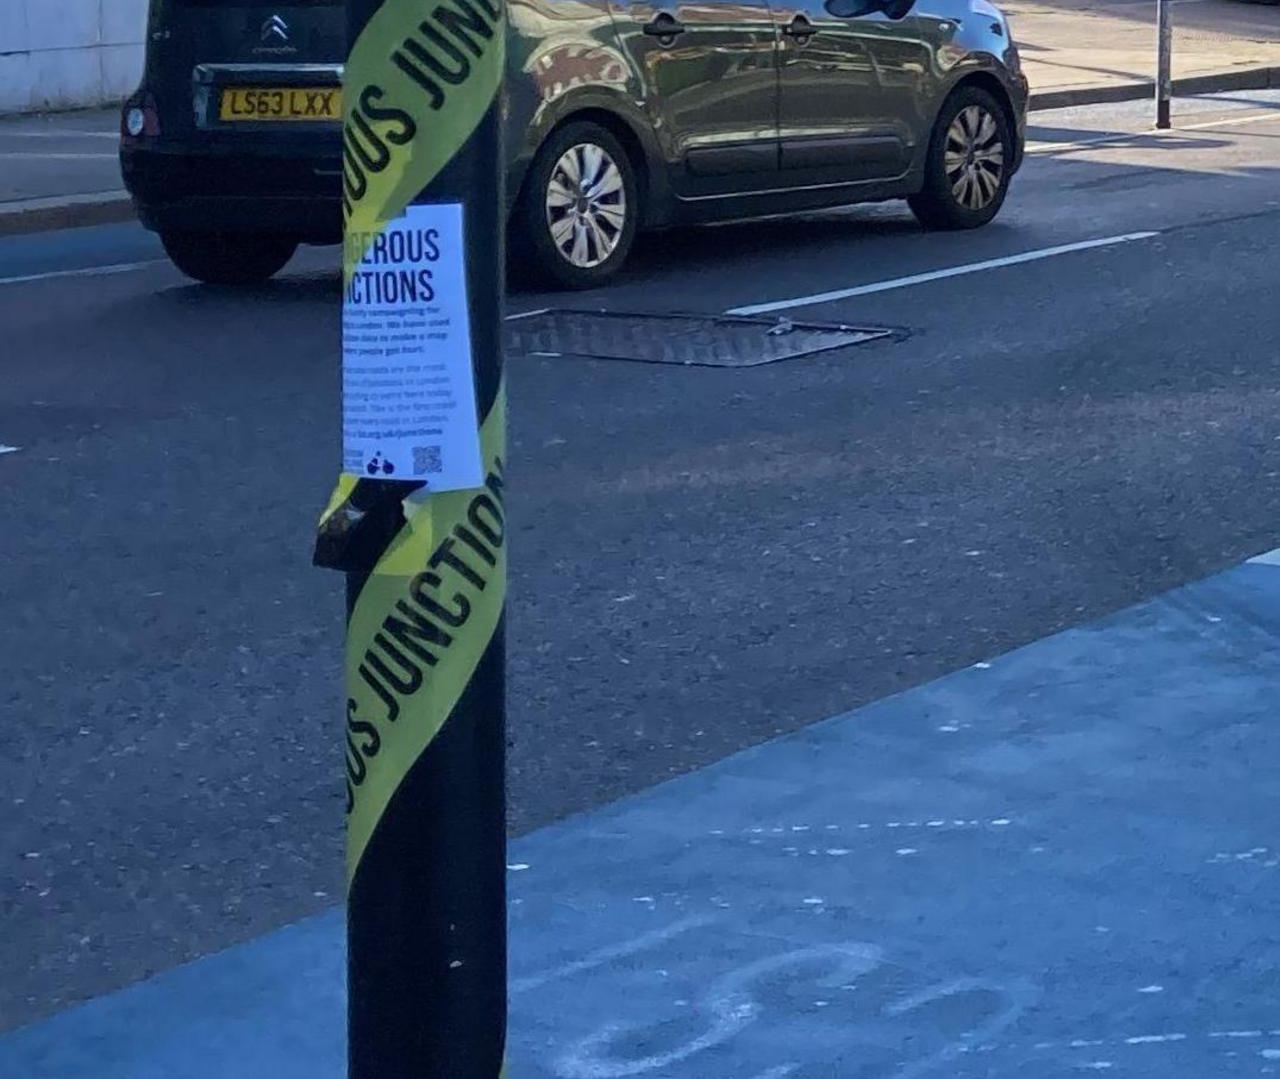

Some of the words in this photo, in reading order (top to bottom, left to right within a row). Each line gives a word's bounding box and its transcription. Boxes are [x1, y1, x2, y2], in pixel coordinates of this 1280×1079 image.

[230, 91, 284, 115] LS63
[289, 90, 335, 116] LXX
[348, 268, 435, 306] CTIONS
